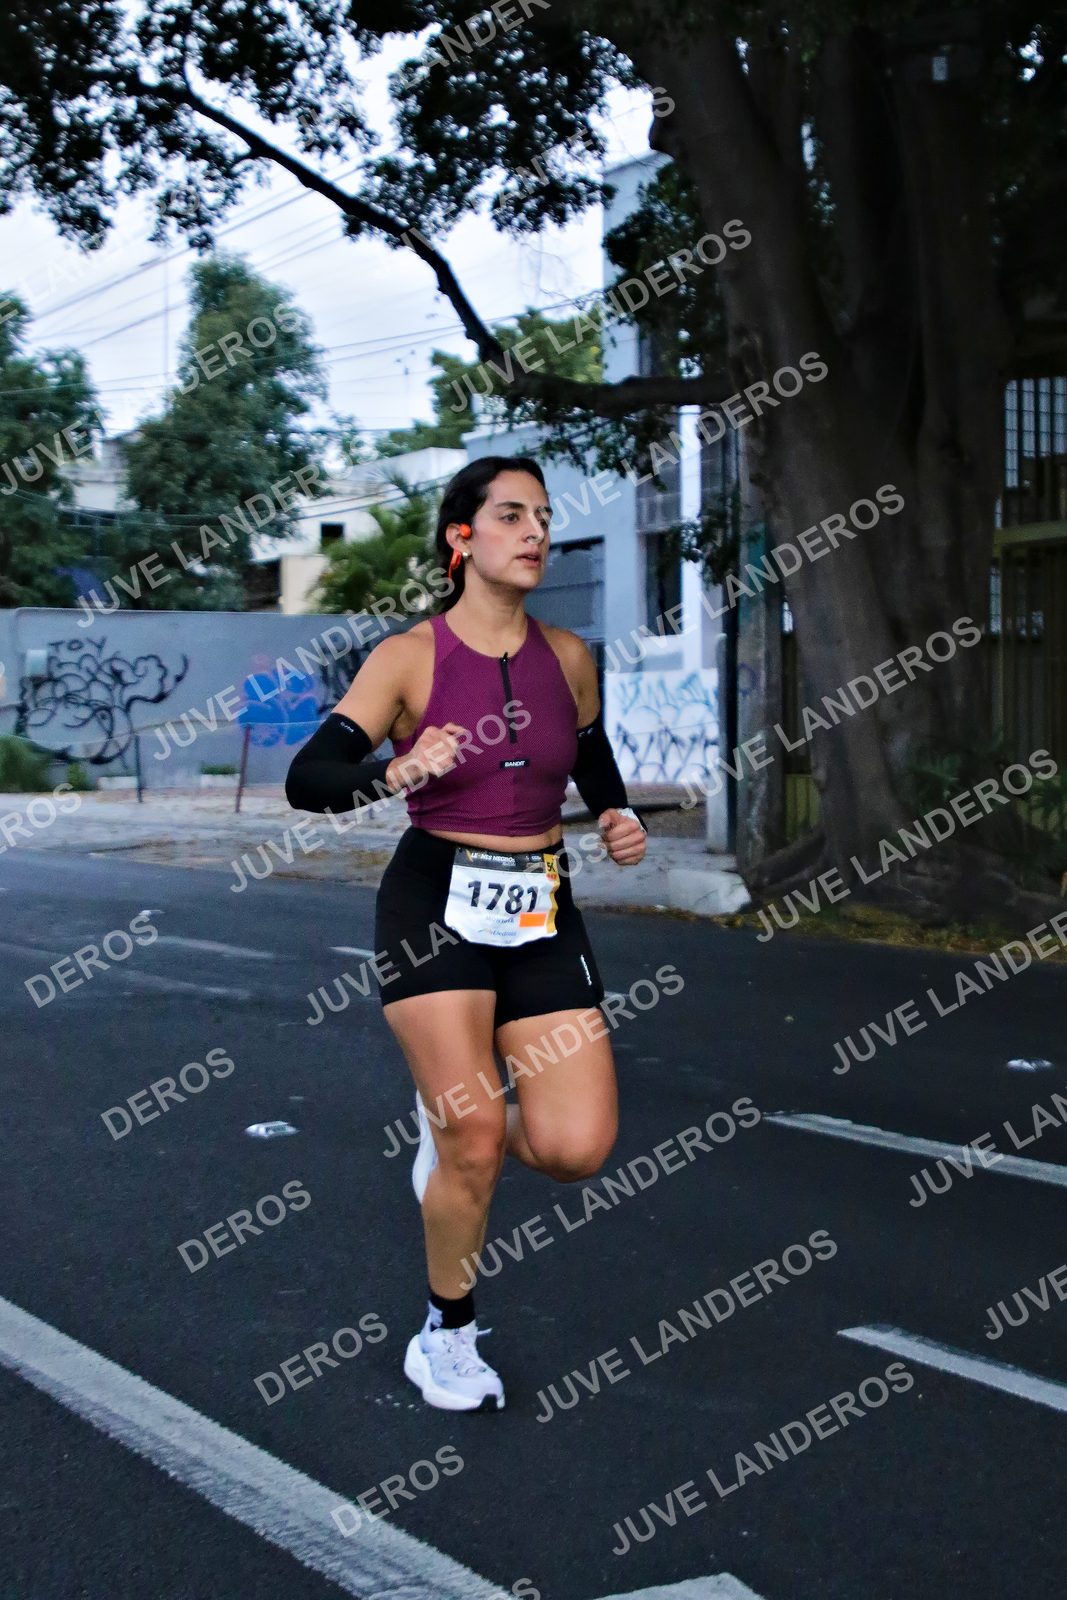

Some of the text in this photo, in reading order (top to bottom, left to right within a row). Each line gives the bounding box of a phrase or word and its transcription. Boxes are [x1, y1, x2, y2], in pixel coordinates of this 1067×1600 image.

[48, 635, 107, 654] TOY
[504, 760, 526, 768] BANDIT
[467, 879, 539, 915] 1781
